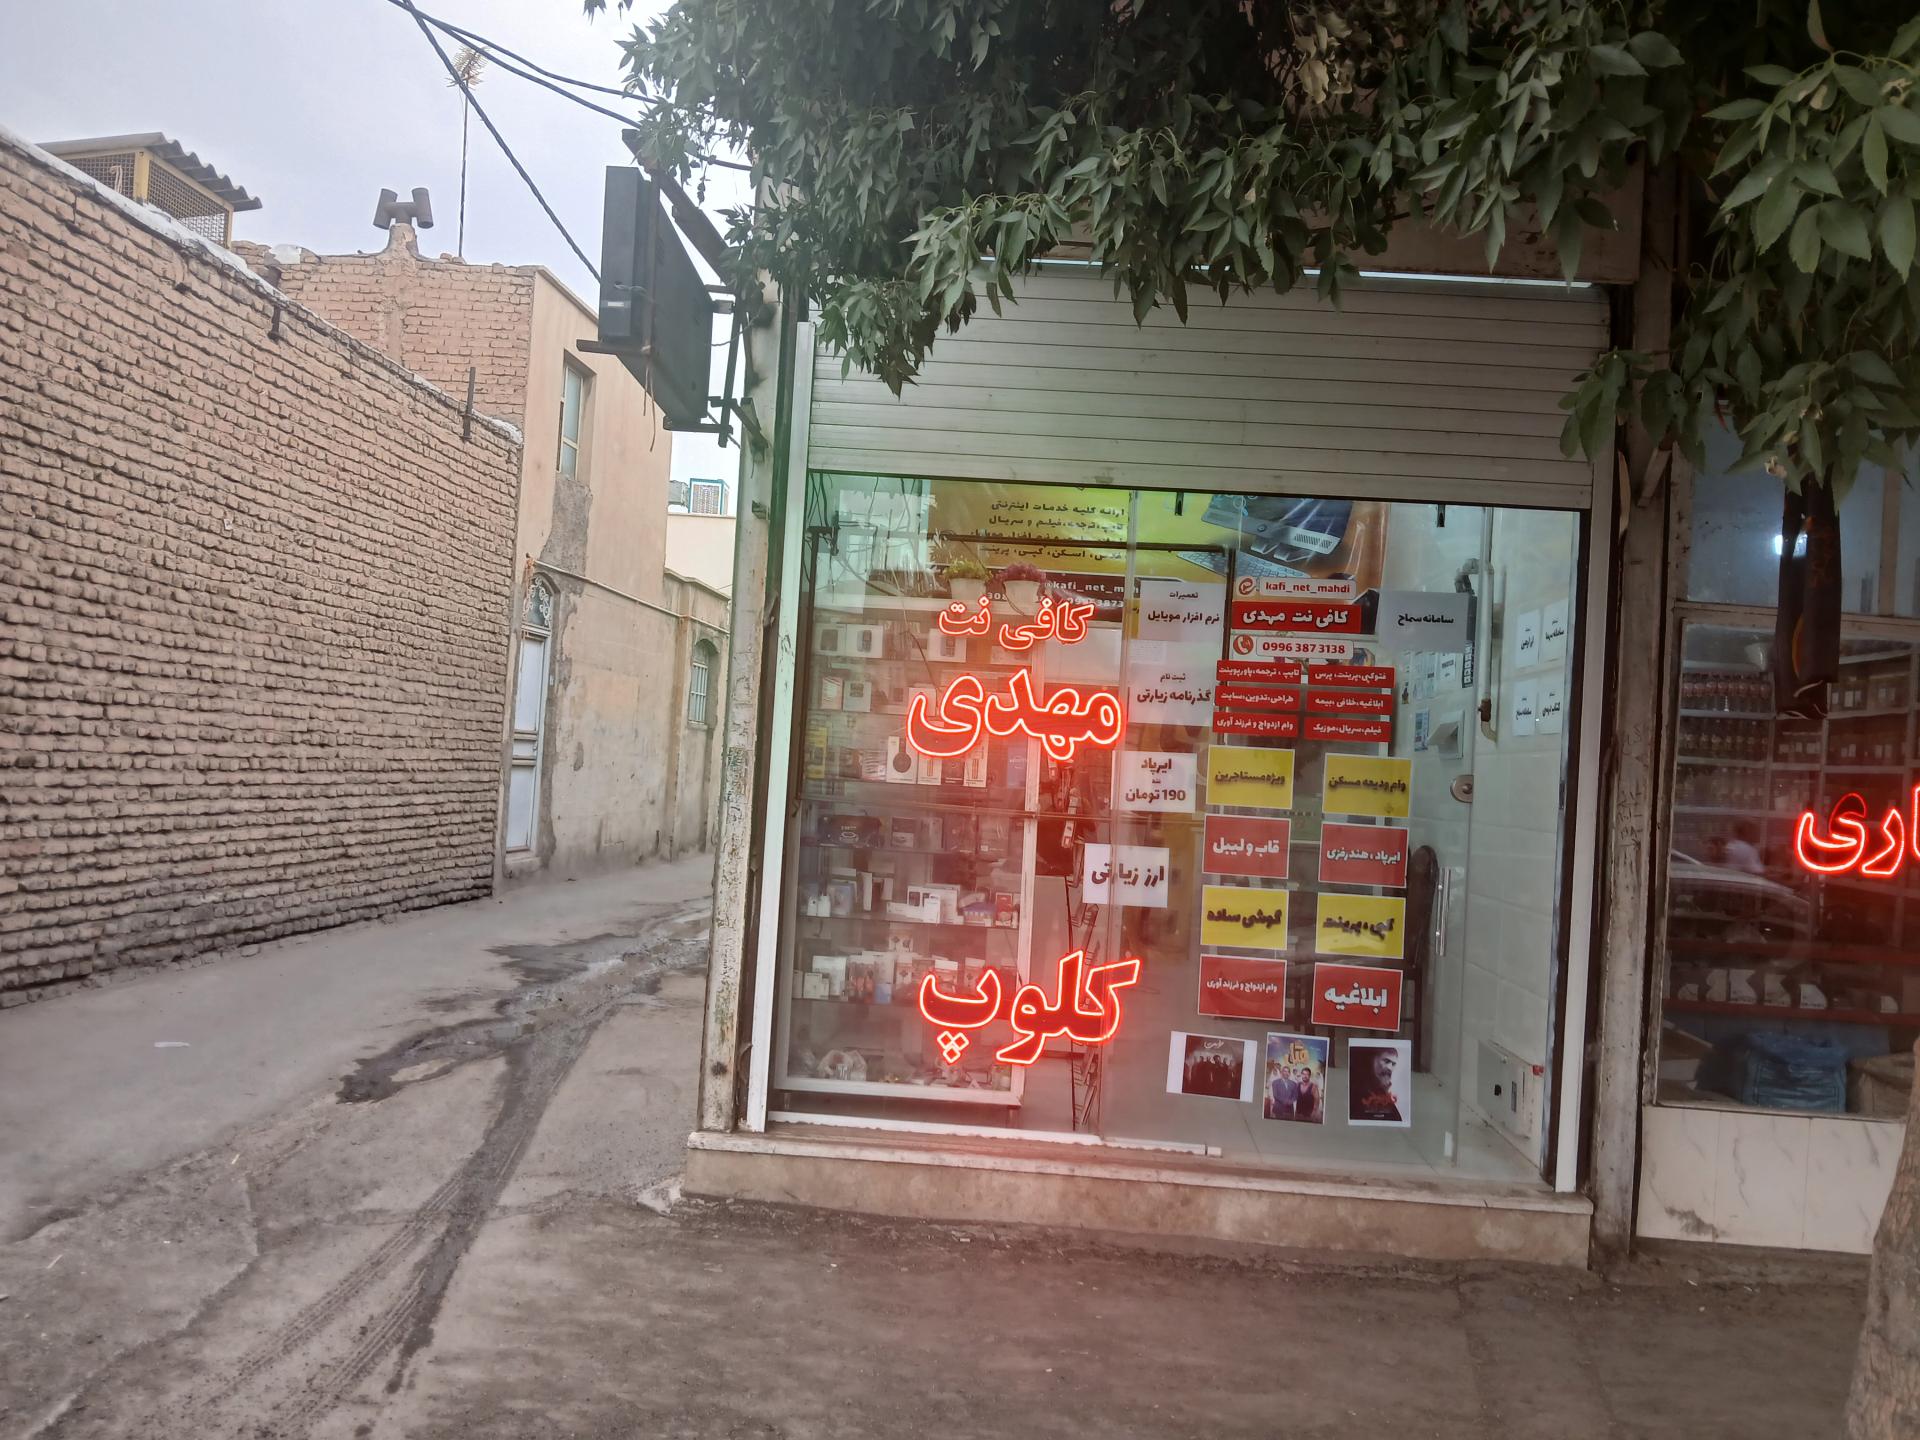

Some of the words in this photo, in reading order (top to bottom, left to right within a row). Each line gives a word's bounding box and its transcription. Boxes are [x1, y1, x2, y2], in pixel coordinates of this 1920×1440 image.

[991, 501, 1029, 511] اینترنتی
[1032, 503, 1068, 513] خدمات
[988, 514, 1023, 526] سریال
[1265, 581, 1351, 594] kafi_net_mahdi
[1169, 590, 1199, 600] تعمیرات
[938, 595, 991, 635] نت
[1147, 610, 1181, 622] موبایل
[1182, 611, 1203, 623] افزار
[1204, 612, 1220, 625] نرم
[1242, 609, 1286, 625] مهدی
[1291, 609, 1313, 622] نت
[1315, 608, 1349, 628] کافی
[1397, 613, 1422, 626] سماح
[1423, 613, 1455, 624] سامانه
[998, 595, 1096, 652] کافی
[1262, 641, 1293, 652] 0996
[1295, 643, 1317, 653] 387
[1319, 644, 1346, 654] 3138
[1160, 673, 1171, 683] نام
[1171, 672, 1186, 681] ثبت
[1136, 689, 1169, 704] زیارتی
[1169, 688, 1212, 705] گذرنامه
[906, 667, 1127, 761] مهدی
[1216, 716, 1233, 727] آوری
[1233, 718, 1252, 728] فرزند
[1252, 720, 1257, 728] و
[1257, 719, 1281, 730] ازدواج
[1280, 720, 1294, 731] وام
[1140, 757, 1172, 774] ایرپاد
[1265, 773, 1286, 786] ویژه
[1328, 775, 1361, 789] مسکن
[1362, 778, 1390, 792] ودیعه
[1389, 779, 1406, 793] وام
[1125, 789, 1160, 803] تومان
[1162, 789, 1186, 801] 190
[1212, 836, 1245, 854] لیبل
[1245, 842, 1252, 856] و
[1254, 838, 1280, 854] قاب
[1143, 865, 1165, 888] ارز
[1206, 908, 1241, 923] ساده
[1241, 908, 1283, 929] گوشی
[1206, 977, 1222, 989] آوری
[1239, 982, 1244, 991] و
[1244, 982, 1265, 993] ازدواج
[1265, 983, 1278, 993] وام
[1323, 981, 1389, 1016] ابلاغیه
[918, 948, 1142, 1066] کلوپ
